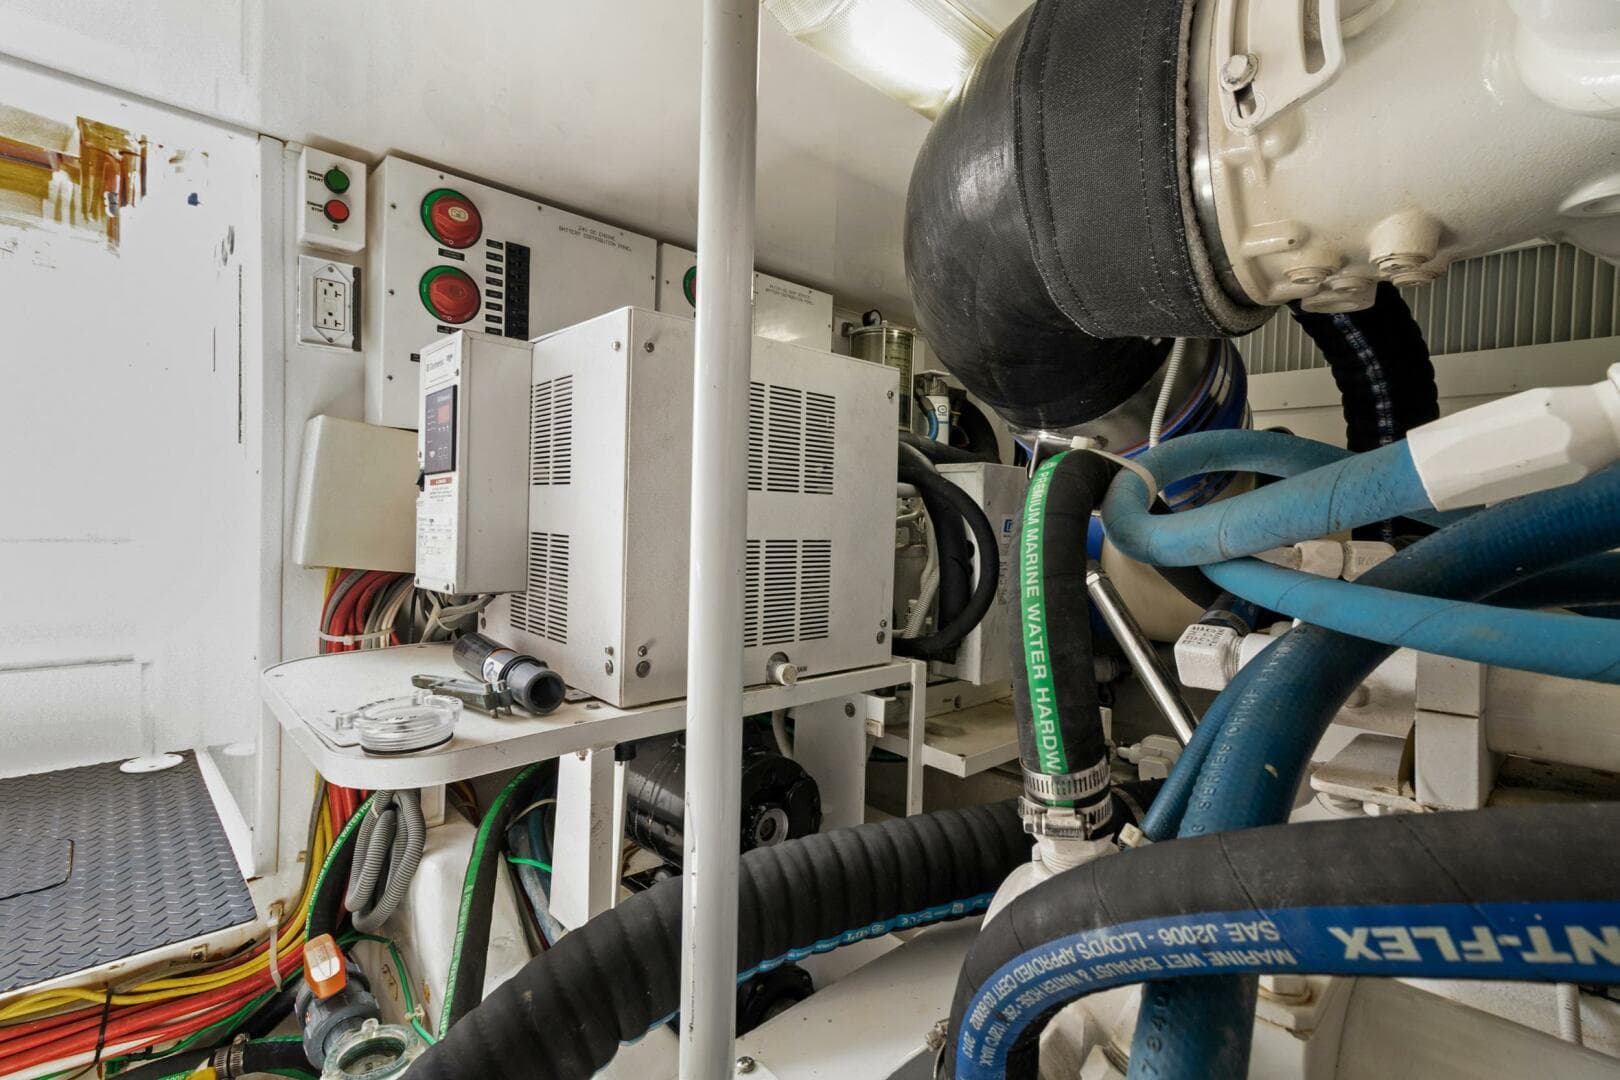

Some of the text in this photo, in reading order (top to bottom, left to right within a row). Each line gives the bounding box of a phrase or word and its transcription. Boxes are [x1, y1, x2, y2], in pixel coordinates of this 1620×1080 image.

[583, 232, 617, 247] DISTRIBUTION
[1025, 470, 1049, 526] PREMIUM
[1026, 527, 1041, 598] MARINE
[1027, 604, 1048, 680] WATER
[1197, 742, 1233, 811] SERIES
[324, 838, 343, 869] MARINE
[340, 811, 363, 839] WATER
[1158, 923, 1219, 946] J2006
[1223, 919, 1280, 941] SAE
[1075, 931, 1147, 961] LLOYD'S
[1203, 947, 1297, 967] MARINE
[1013, 946, 1076, 984] APPROVED
[1091, 955, 1162, 980] EXHAUST
[1161, 952, 1206, 969] WET
[992, 972, 1018, 1002] CERT
[1042, 971, 1083, 996] WATER
[1016, 986, 1043, 1009] HOSE
[978, 1046, 993, 1067] MAX
